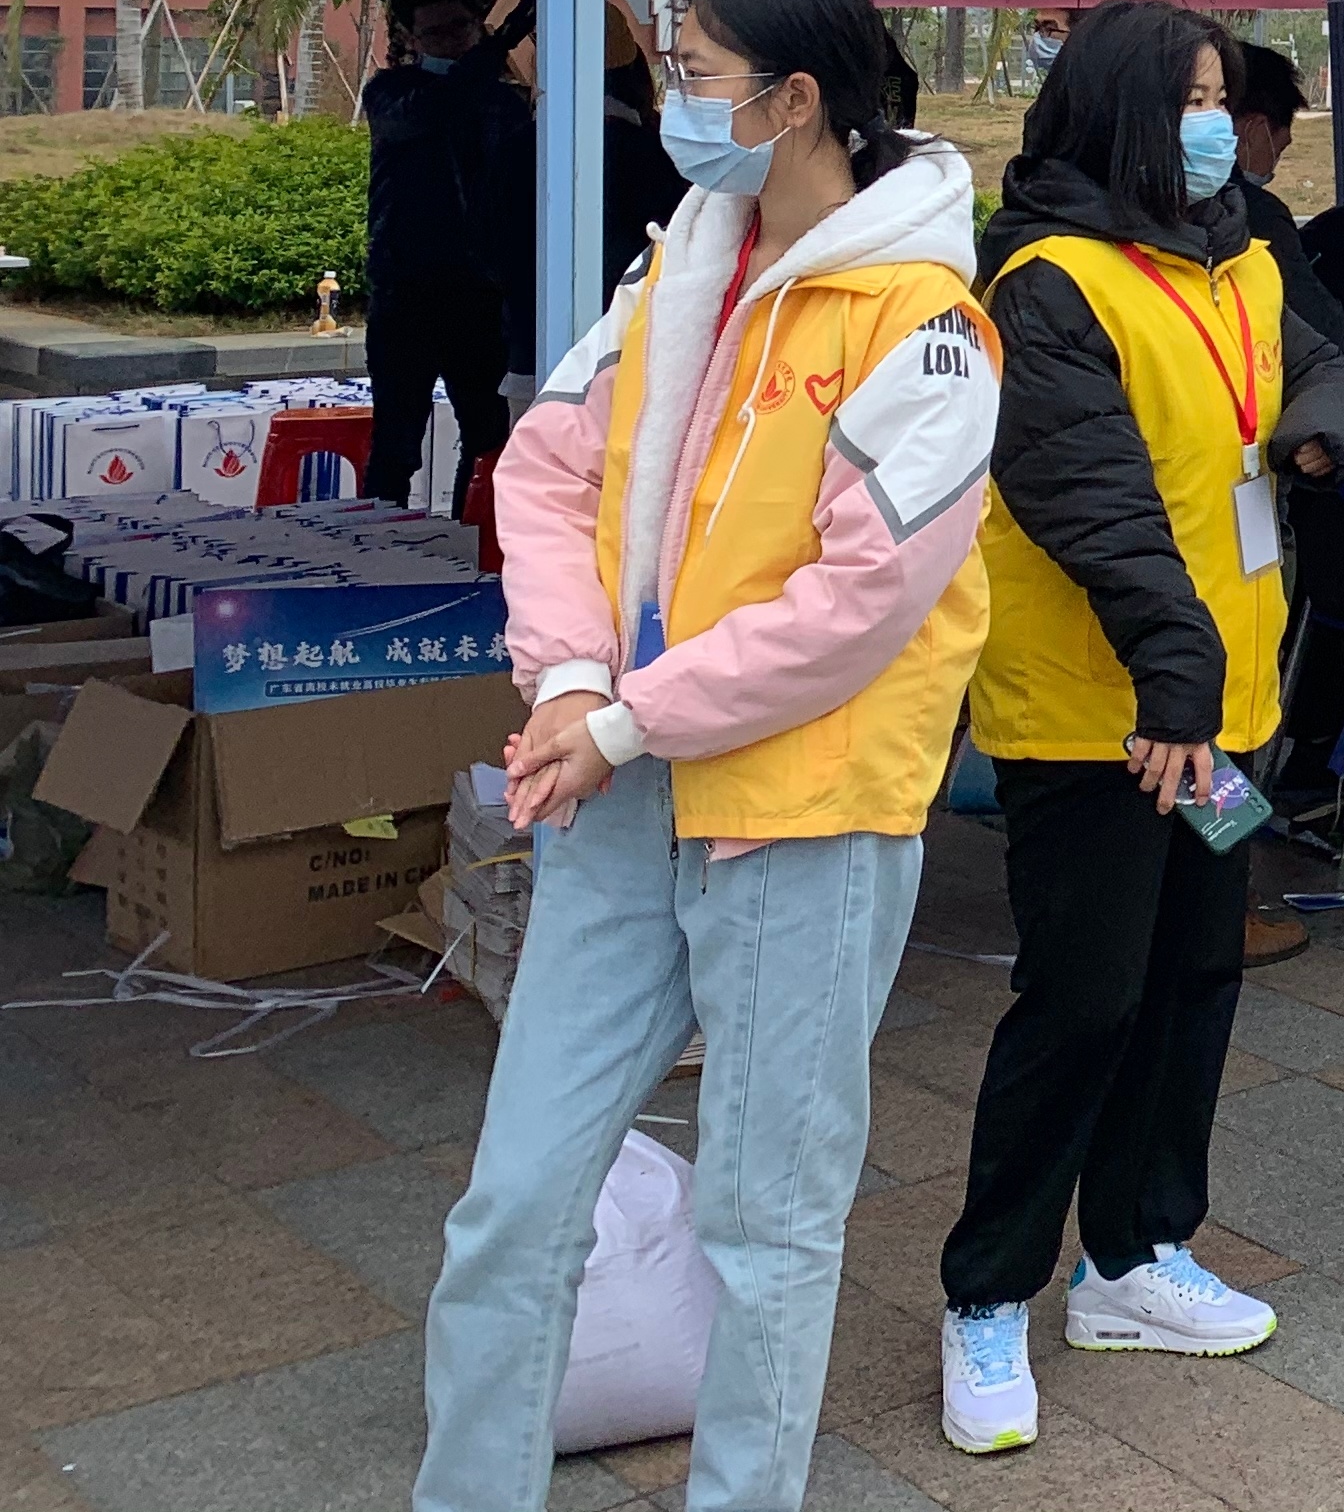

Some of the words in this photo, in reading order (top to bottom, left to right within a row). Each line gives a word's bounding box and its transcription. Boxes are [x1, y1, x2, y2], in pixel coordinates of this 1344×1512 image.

[222, 639, 361, 675] 梦想起航
[385, 632, 510, 667] 成就未来
[308, 876, 371, 903] MADE
[376, 871, 398, 891] IN
